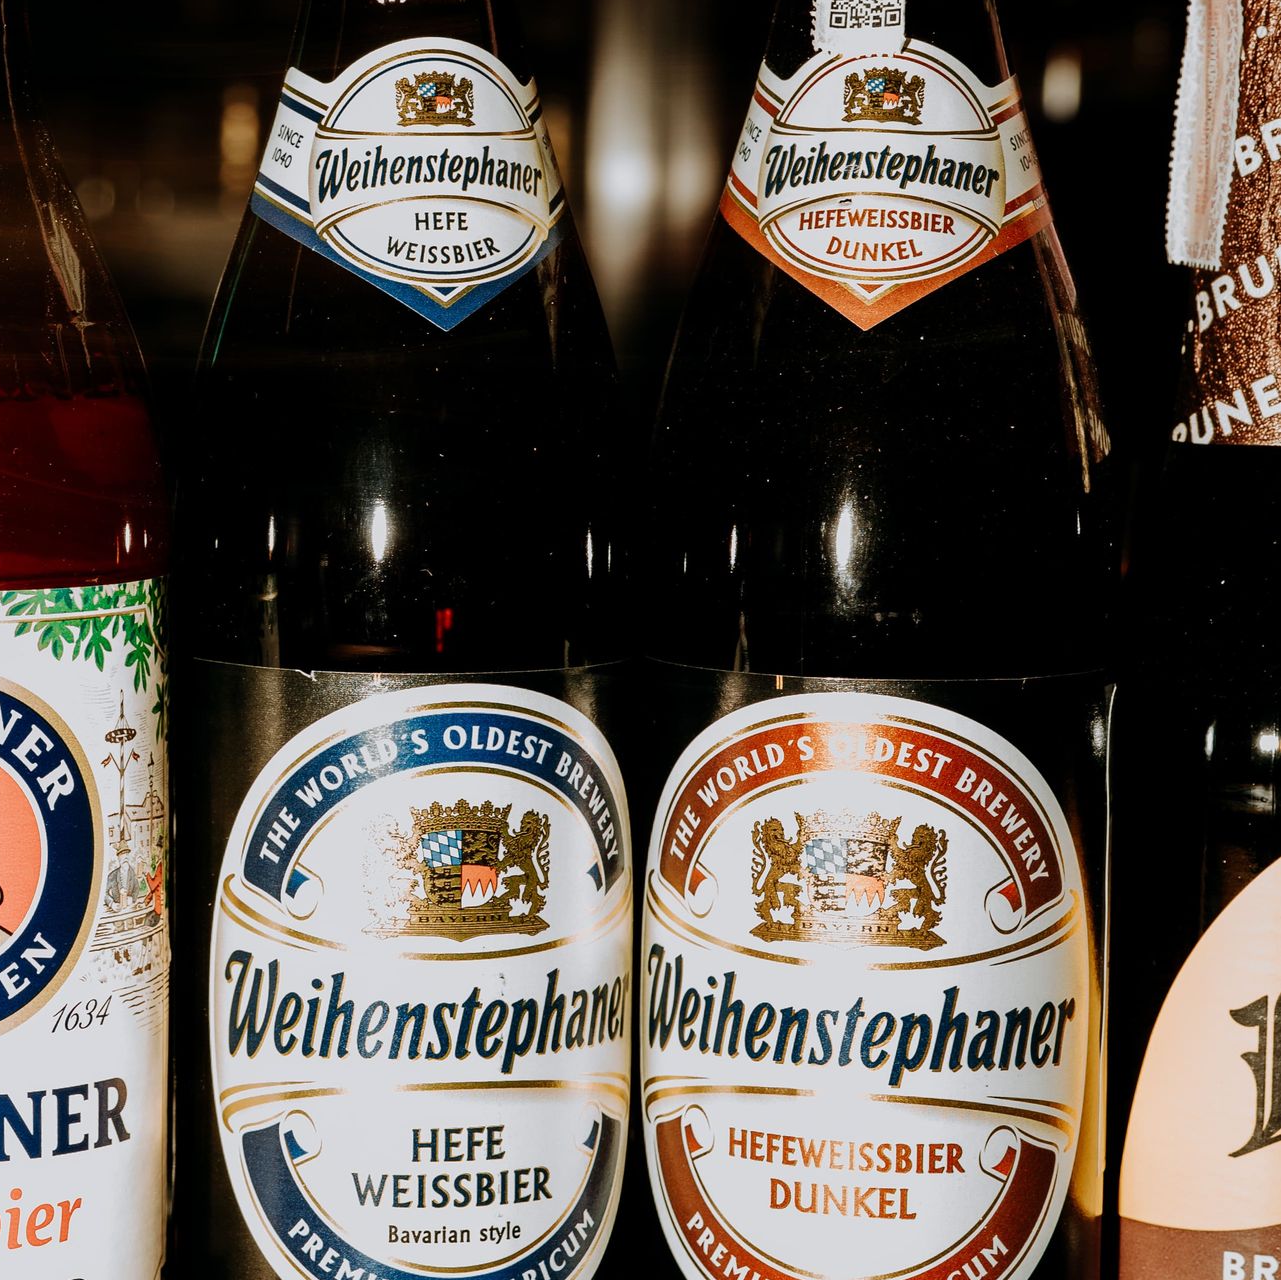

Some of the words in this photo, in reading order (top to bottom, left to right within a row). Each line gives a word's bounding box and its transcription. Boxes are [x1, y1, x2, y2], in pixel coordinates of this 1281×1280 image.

[277, 124, 304, 149] SINCE
[271, 147, 292, 169] 1040
[316, 145, 542, 203] Weihenstephaner
[764, 140, 1000, 199] Weihenstephaner
[415, 212, 468, 232] HEFE
[799, 209, 956, 235] HEFEWEISSBIER
[387, 236, 501, 265] WEISSBIER
[826, 236, 923, 262] DUNKEL
[1195, 245, 1281, 334] BRU
[259, 806, 300, 864] THE
[295, 729, 429, 809] WORLD'S
[442, 725, 553, 763] OLDEST
[556, 750, 619, 862] BREWERY
[670, 804, 701, 861] THE
[697, 735, 814, 806] WORLD'S
[828, 734, 953, 779] OLDEST
[955, 767, 1049, 881] BREWERY
[51, 995, 111, 1033] 1634
[225, 949, 629, 1074] Weihenstephaner
[647, 944, 1076, 1087] Weihenstephaner
[411, 1124, 506, 1162] HEFE
[728, 1127, 966, 1174] HEFEWEISSBIER
[351, 1165, 553, 1209] WEISSBIER
[769, 1178, 917, 1220] DUNKEL
[388, 1224, 470, 1243] Bavarian
[480, 1220, 521, 1244] style
